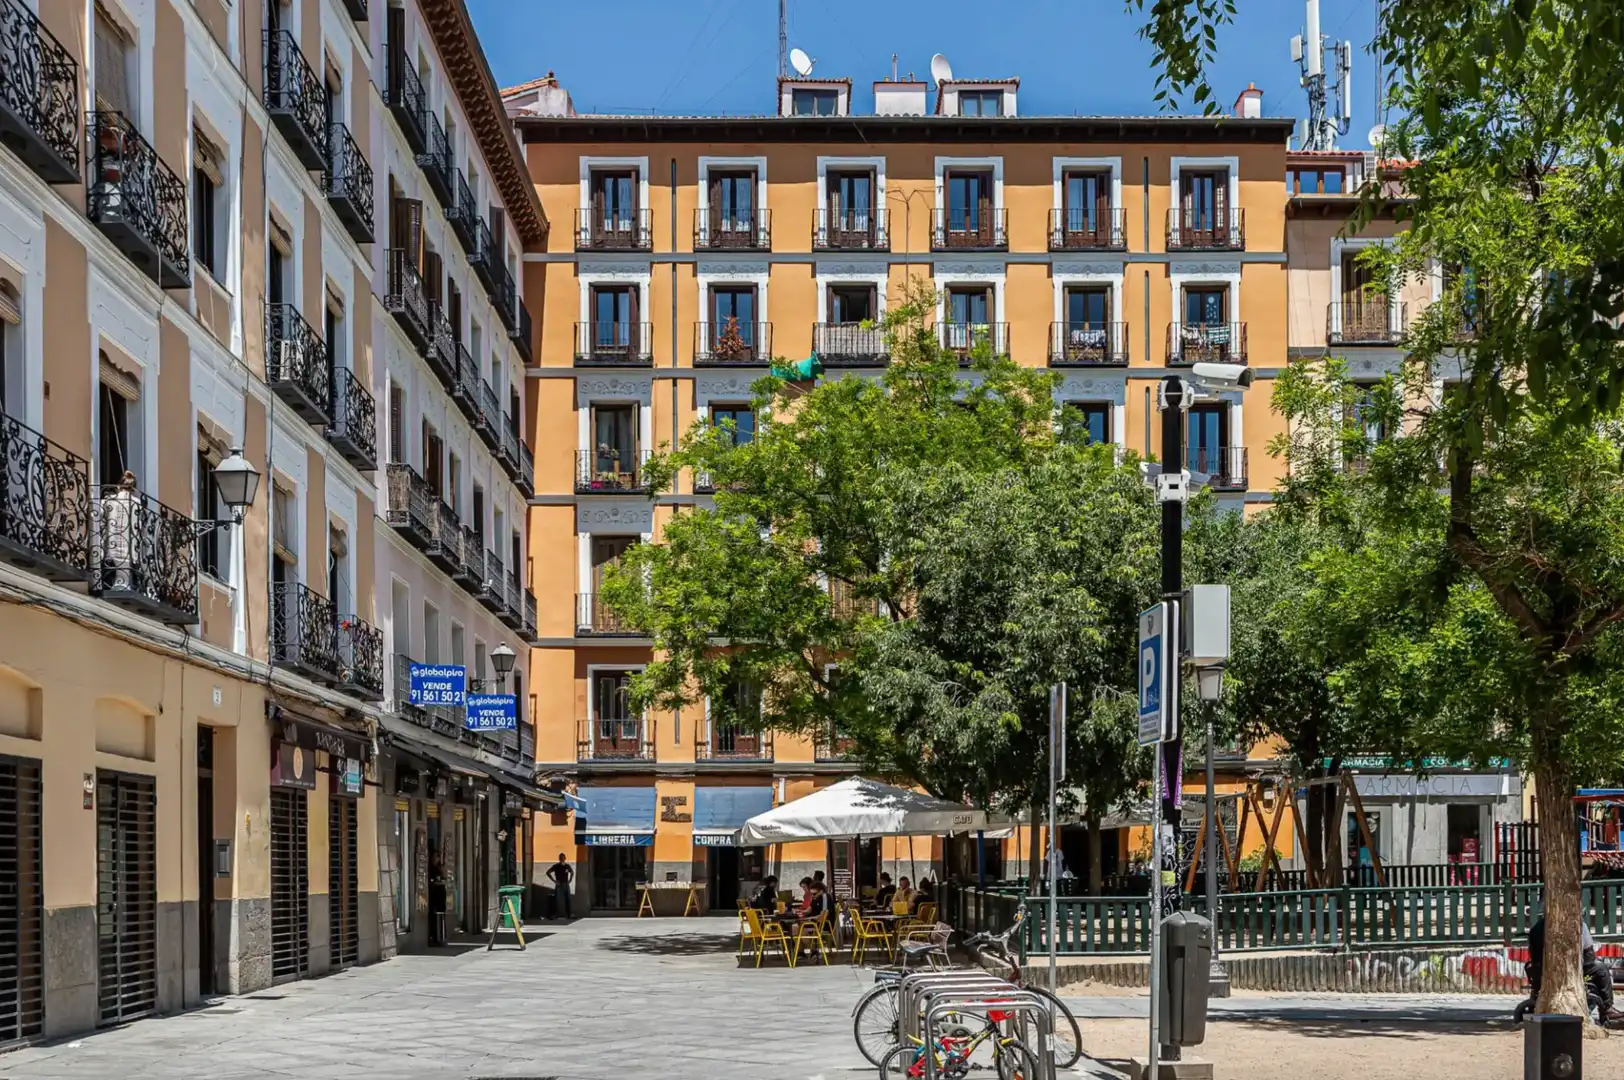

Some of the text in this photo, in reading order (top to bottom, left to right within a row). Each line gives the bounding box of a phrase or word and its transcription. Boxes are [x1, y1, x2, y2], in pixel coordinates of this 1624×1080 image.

[420, 667, 463, 678] globalpiso
[422, 682, 452, 691] VENDE
[411, 691, 465, 702] 91 561 50 21
[475, 696, 514, 706] globalpiso
[479, 709, 505, 717] VENDE
[468, 717, 516, 726] 91 561 50 21
[1356, 776, 1472, 793] ARMACIA
[592, 835, 636, 845] LIBRERIA
[695, 835, 732, 845] COMPRA
